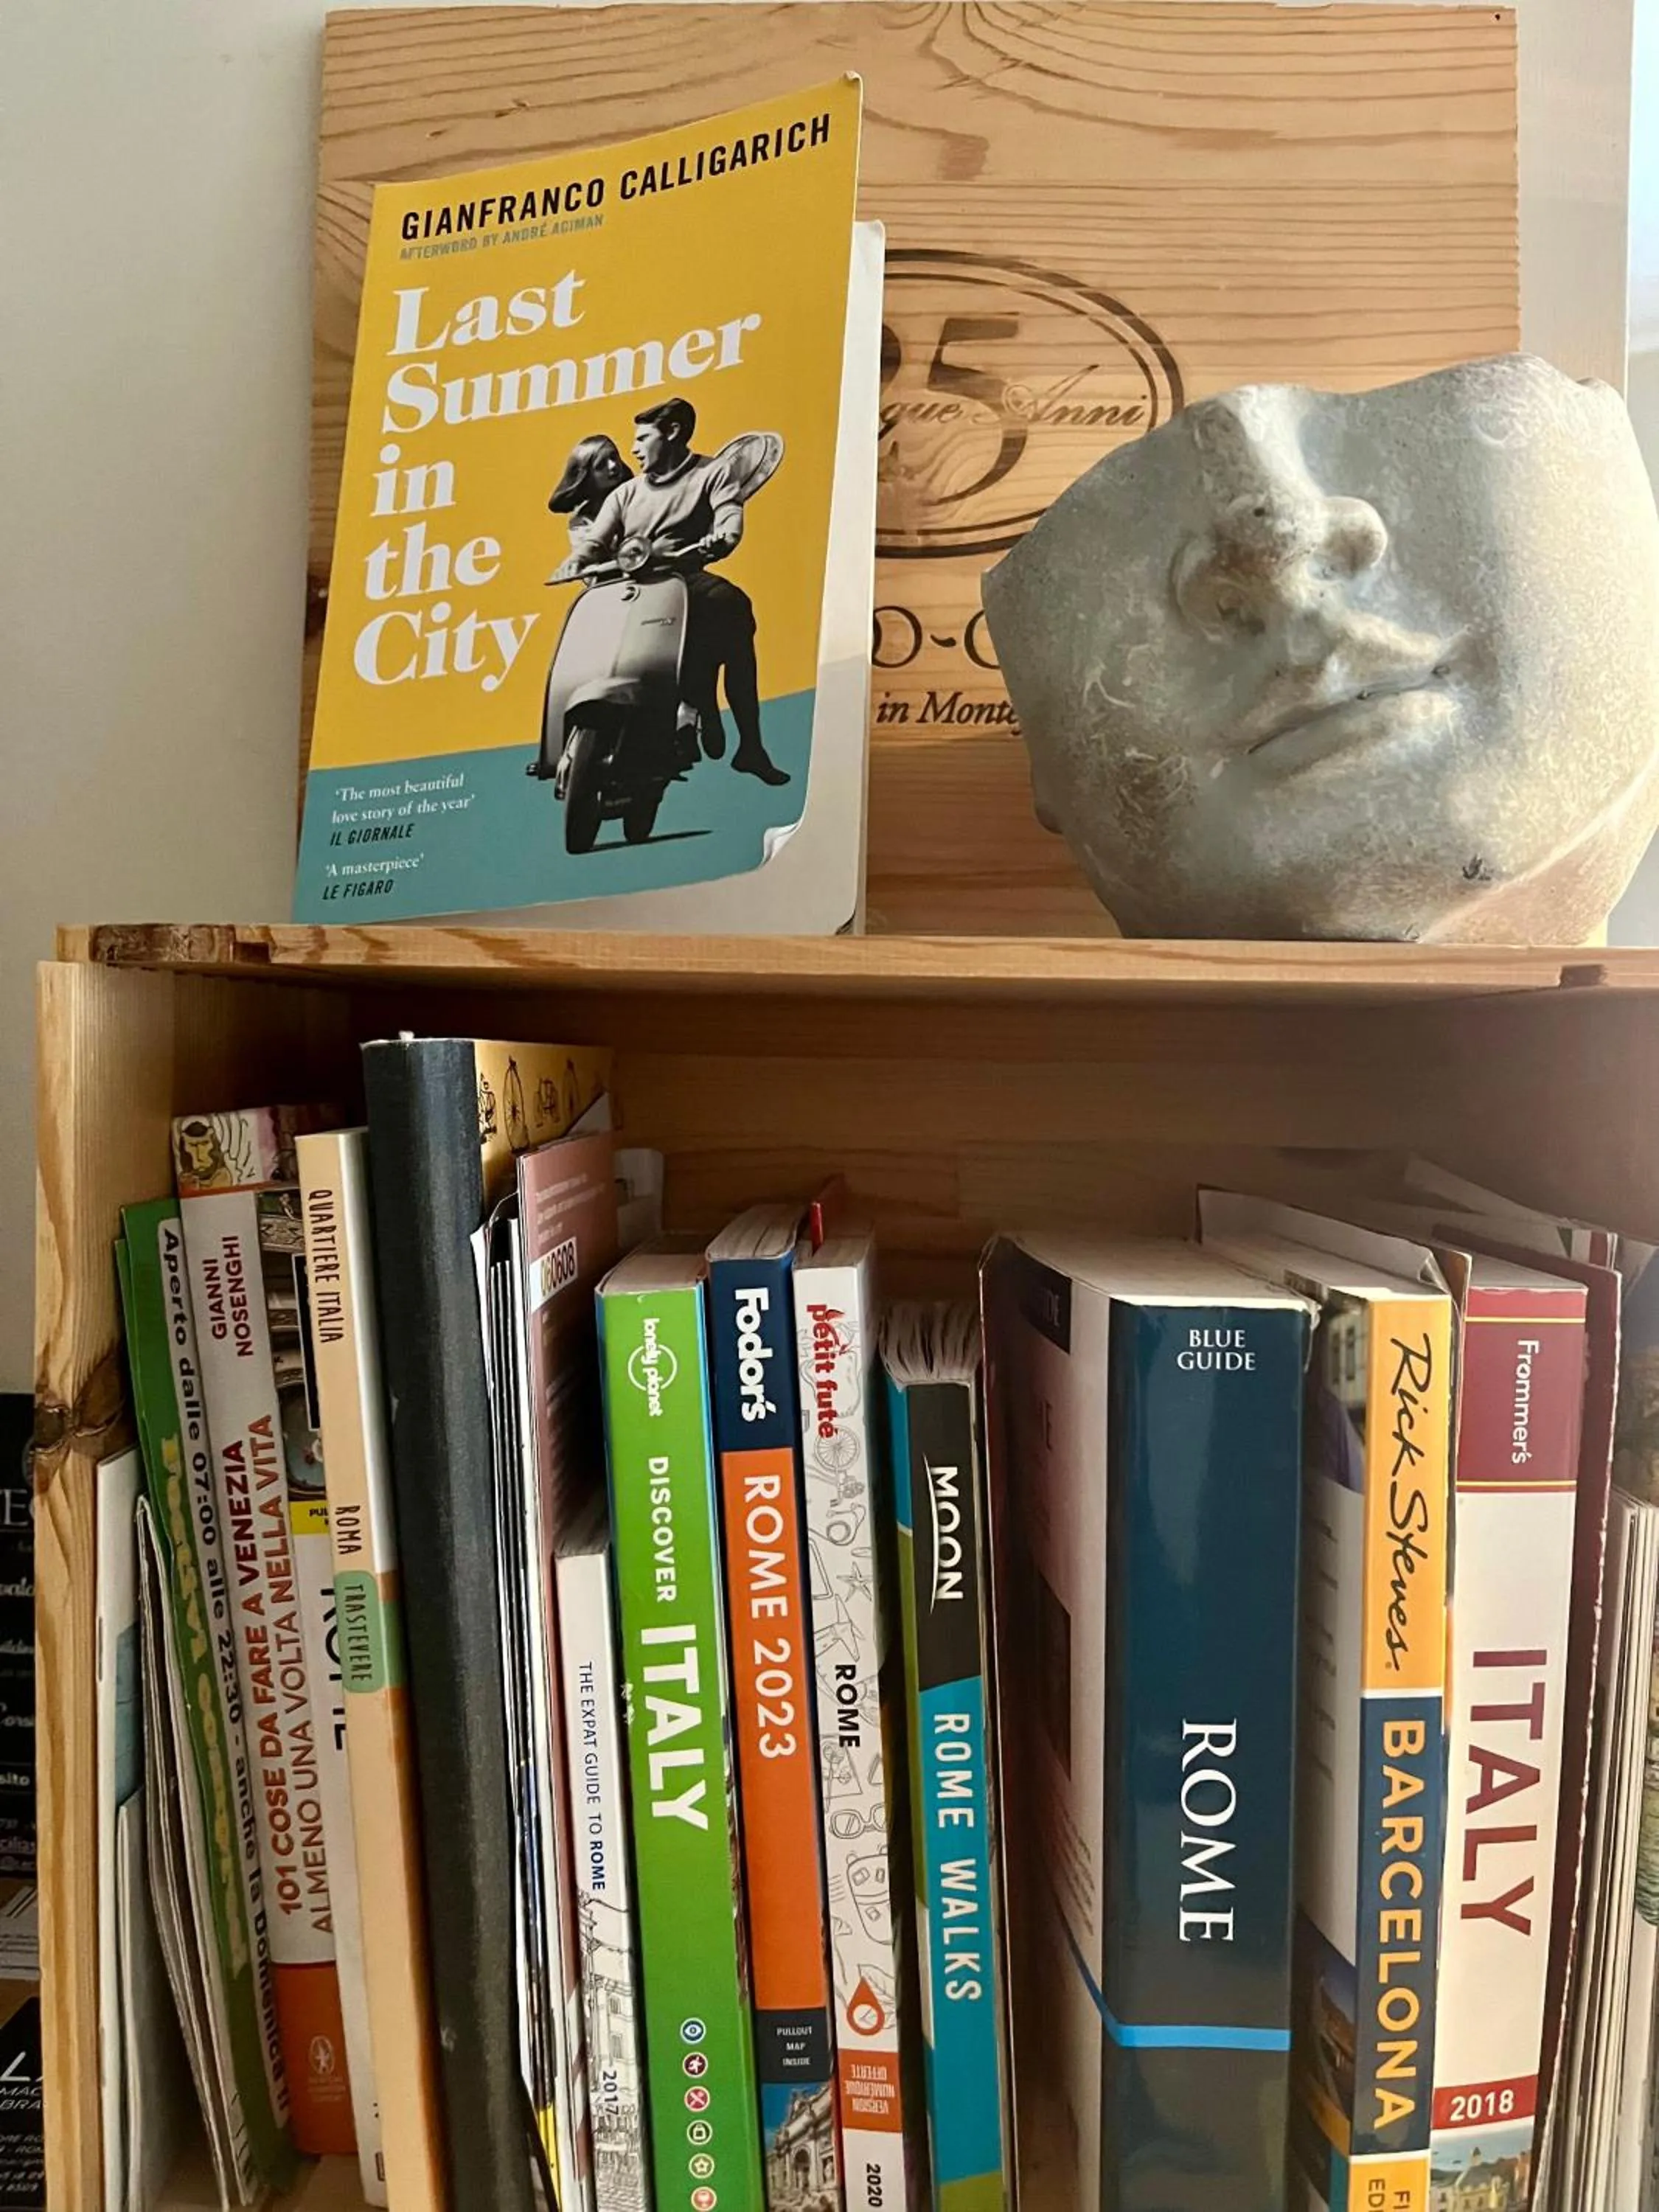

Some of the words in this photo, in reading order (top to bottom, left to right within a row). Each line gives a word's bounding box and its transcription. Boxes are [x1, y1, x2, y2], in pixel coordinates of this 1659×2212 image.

[401, 178, 604, 241] GIANFRANCO
[619, 113, 831, 201] CALLIGARICH
[400, 237, 478, 260] AFTERWORD
[482, 233, 498, 248] BY
[502, 222, 548, 244] ANDRÉ
[552, 214, 604, 234] ACIMAN
[386, 269, 588, 357] Last
[382, 313, 762, 434] Summer
[370, 443, 456, 516] in
[365, 521, 501, 600] the
[353, 602, 540, 692] City
[876, 691, 910, 724] in
[332, 810, 358, 824] love
[361, 804, 394, 821] story
[397, 800, 414, 815] of
[417, 799, 438, 814] the
[369, 785, 401, 799] most
[405, 773, 465, 794] beautiful
[330, 831, 341, 846] IL
[348, 823, 415, 845] GIORNALE
[322, 884, 339, 900] LE
[343, 879, 394, 898] FIGARO
[308, 1189, 341, 1284] QUARTIERE
[203, 1257, 228, 1340] GIANNI
[222, 1235, 254, 1358] NOSENGHI
[316, 1290, 346, 1344] ITALIA
[640, 1318, 661, 1365] lonely
[734, 1286, 777, 1423] Fodor's
[806, 1303, 838, 1374] petit
[1176, 1351, 1257, 1372] GUIDE
[1189, 1328, 1247, 1349] BLUE
[642, 1367, 664, 1417] planet
[813, 1379, 839, 1439] futé
[1390, 1332, 1433, 1477] Rick
[1511, 1338, 1540, 1465] Frommer's
[248, 1414, 278, 1493] VITA
[222, 1439, 261, 1587] VENEZIA
[260, 1495, 296, 1605] NELLA
[335, 1504, 363, 1557] ROMA
[648, 1455, 678, 1603] DISCOVER
[743, 1473, 789, 1620] ROME
[929, 1466, 964, 1601] MOON
[164, 1228, 187, 1346] Aperto
[178, 1354, 201, 1441] dalle
[192, 1453, 217, 1546] 07:00
[206, 1557, 226, 1621] alle
[218, 1633, 242, 1725] 22:30
[235, 1757, 257, 1857] anche
[248, 1867, 262, 1899] la
[242, 1591, 266, 1616] A
[344, 1583, 373, 1683] TRASTEVERE
[246, 1624, 276, 1705] FARE
[275, 1610, 308, 1714] VOLTA
[579, 1660, 594, 1694] THE
[753, 1637, 797, 1760] 2023
[258, 1711, 284, 1759] DA
[580, 1698, 599, 1747] EXPAT
[641, 1624, 709, 1832] ITALY
[834, 1663, 861, 1749] ROME
[288, 1719, 319, 1790] UNA
[584, 1752, 602, 1806] GUIDE
[933, 1712, 975, 1829] ROME
[1460, 1648, 1548, 1938] ITALY
[261, 1768, 295, 1859] COSE
[588, 1813, 603, 1836] TO
[1179, 1717, 1238, 1944] ROME
[277, 1865, 302, 1916] 101
[298, 1799, 334, 1933] ALMENO
[590, 1840, 606, 1891] ROME
[940, 1858, 983, 2001] WALKS
[1374, 1719, 1426, 2130] BARCELONA
[776, 2025, 813, 2036] PULLOUT
[786, 2042, 806, 2051] MAP
[601, 2069, 618, 2117] 2017
[1450, 2089, 1514, 2121] 2018
[866, 2163, 883, 2208] 2020
